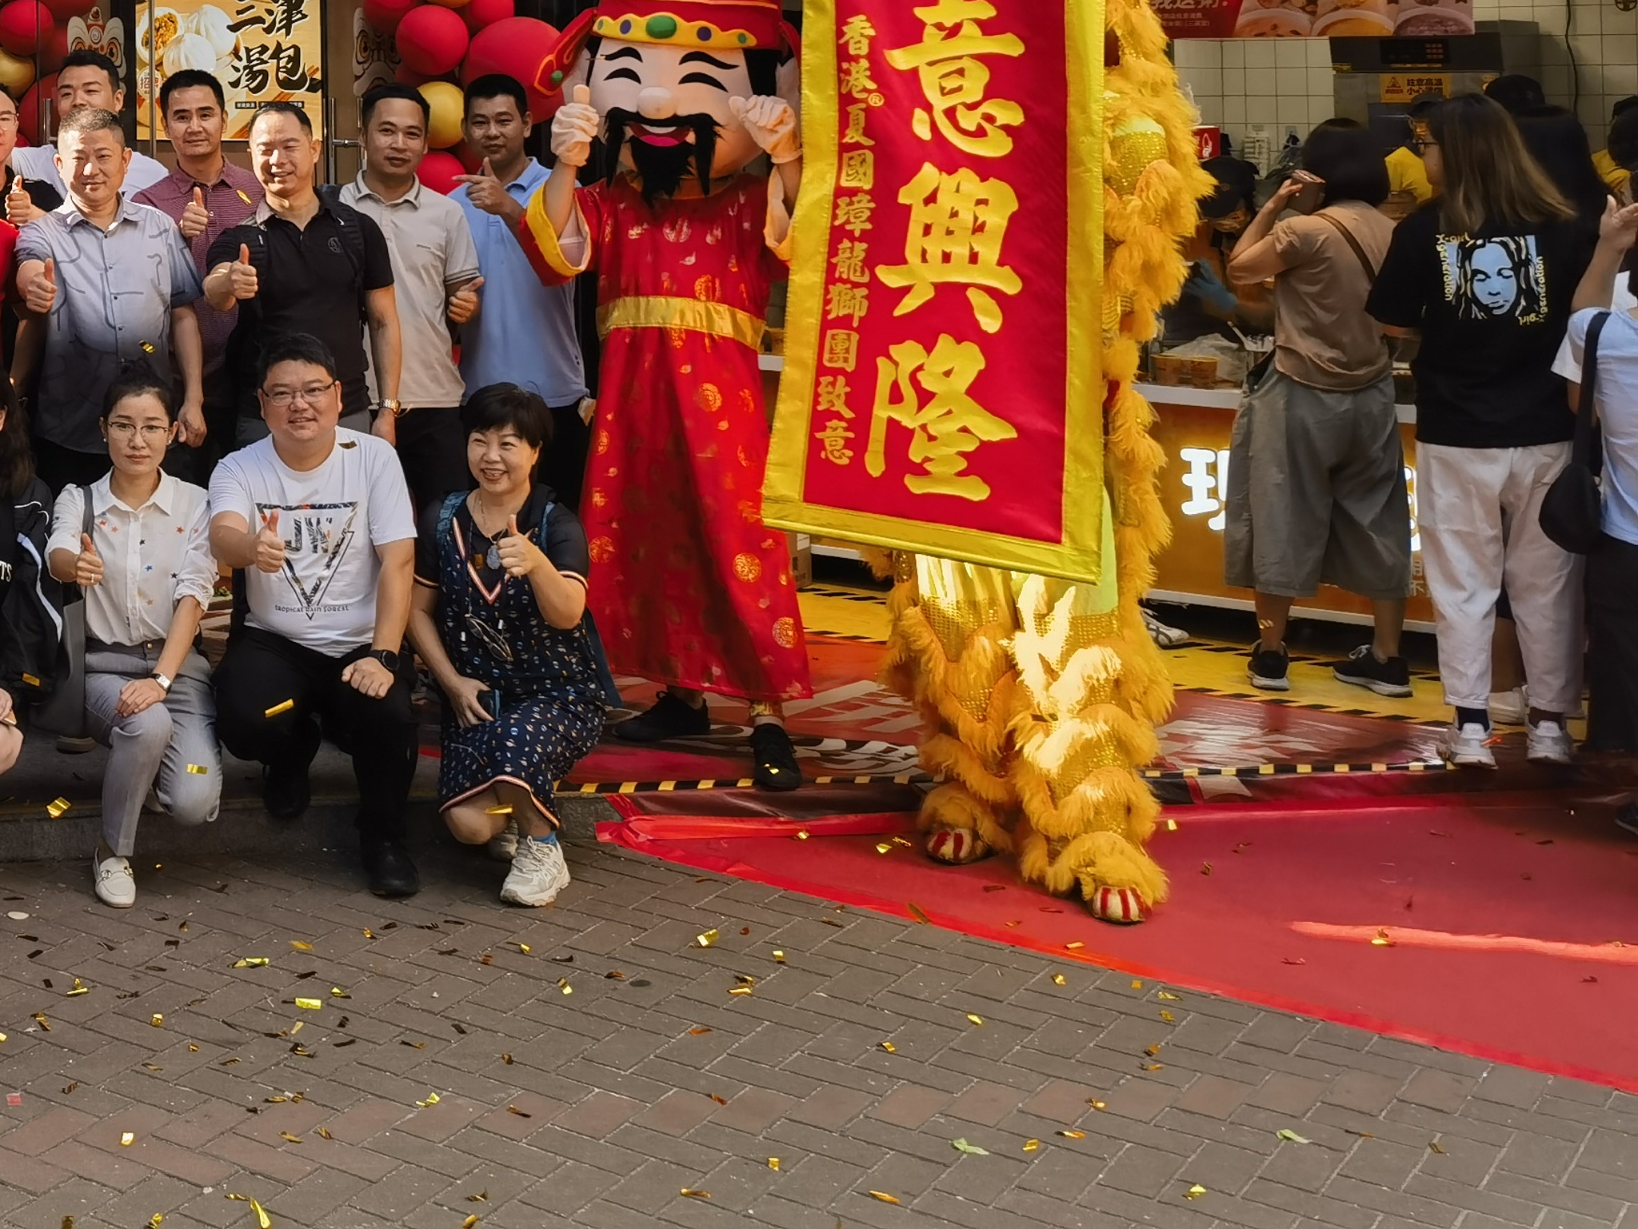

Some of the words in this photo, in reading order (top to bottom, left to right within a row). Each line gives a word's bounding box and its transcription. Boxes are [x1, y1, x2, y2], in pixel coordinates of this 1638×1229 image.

[229, 39, 322, 94] 湯包
[813, 13, 878, 467] 香港夏國璋龍獅團致意
